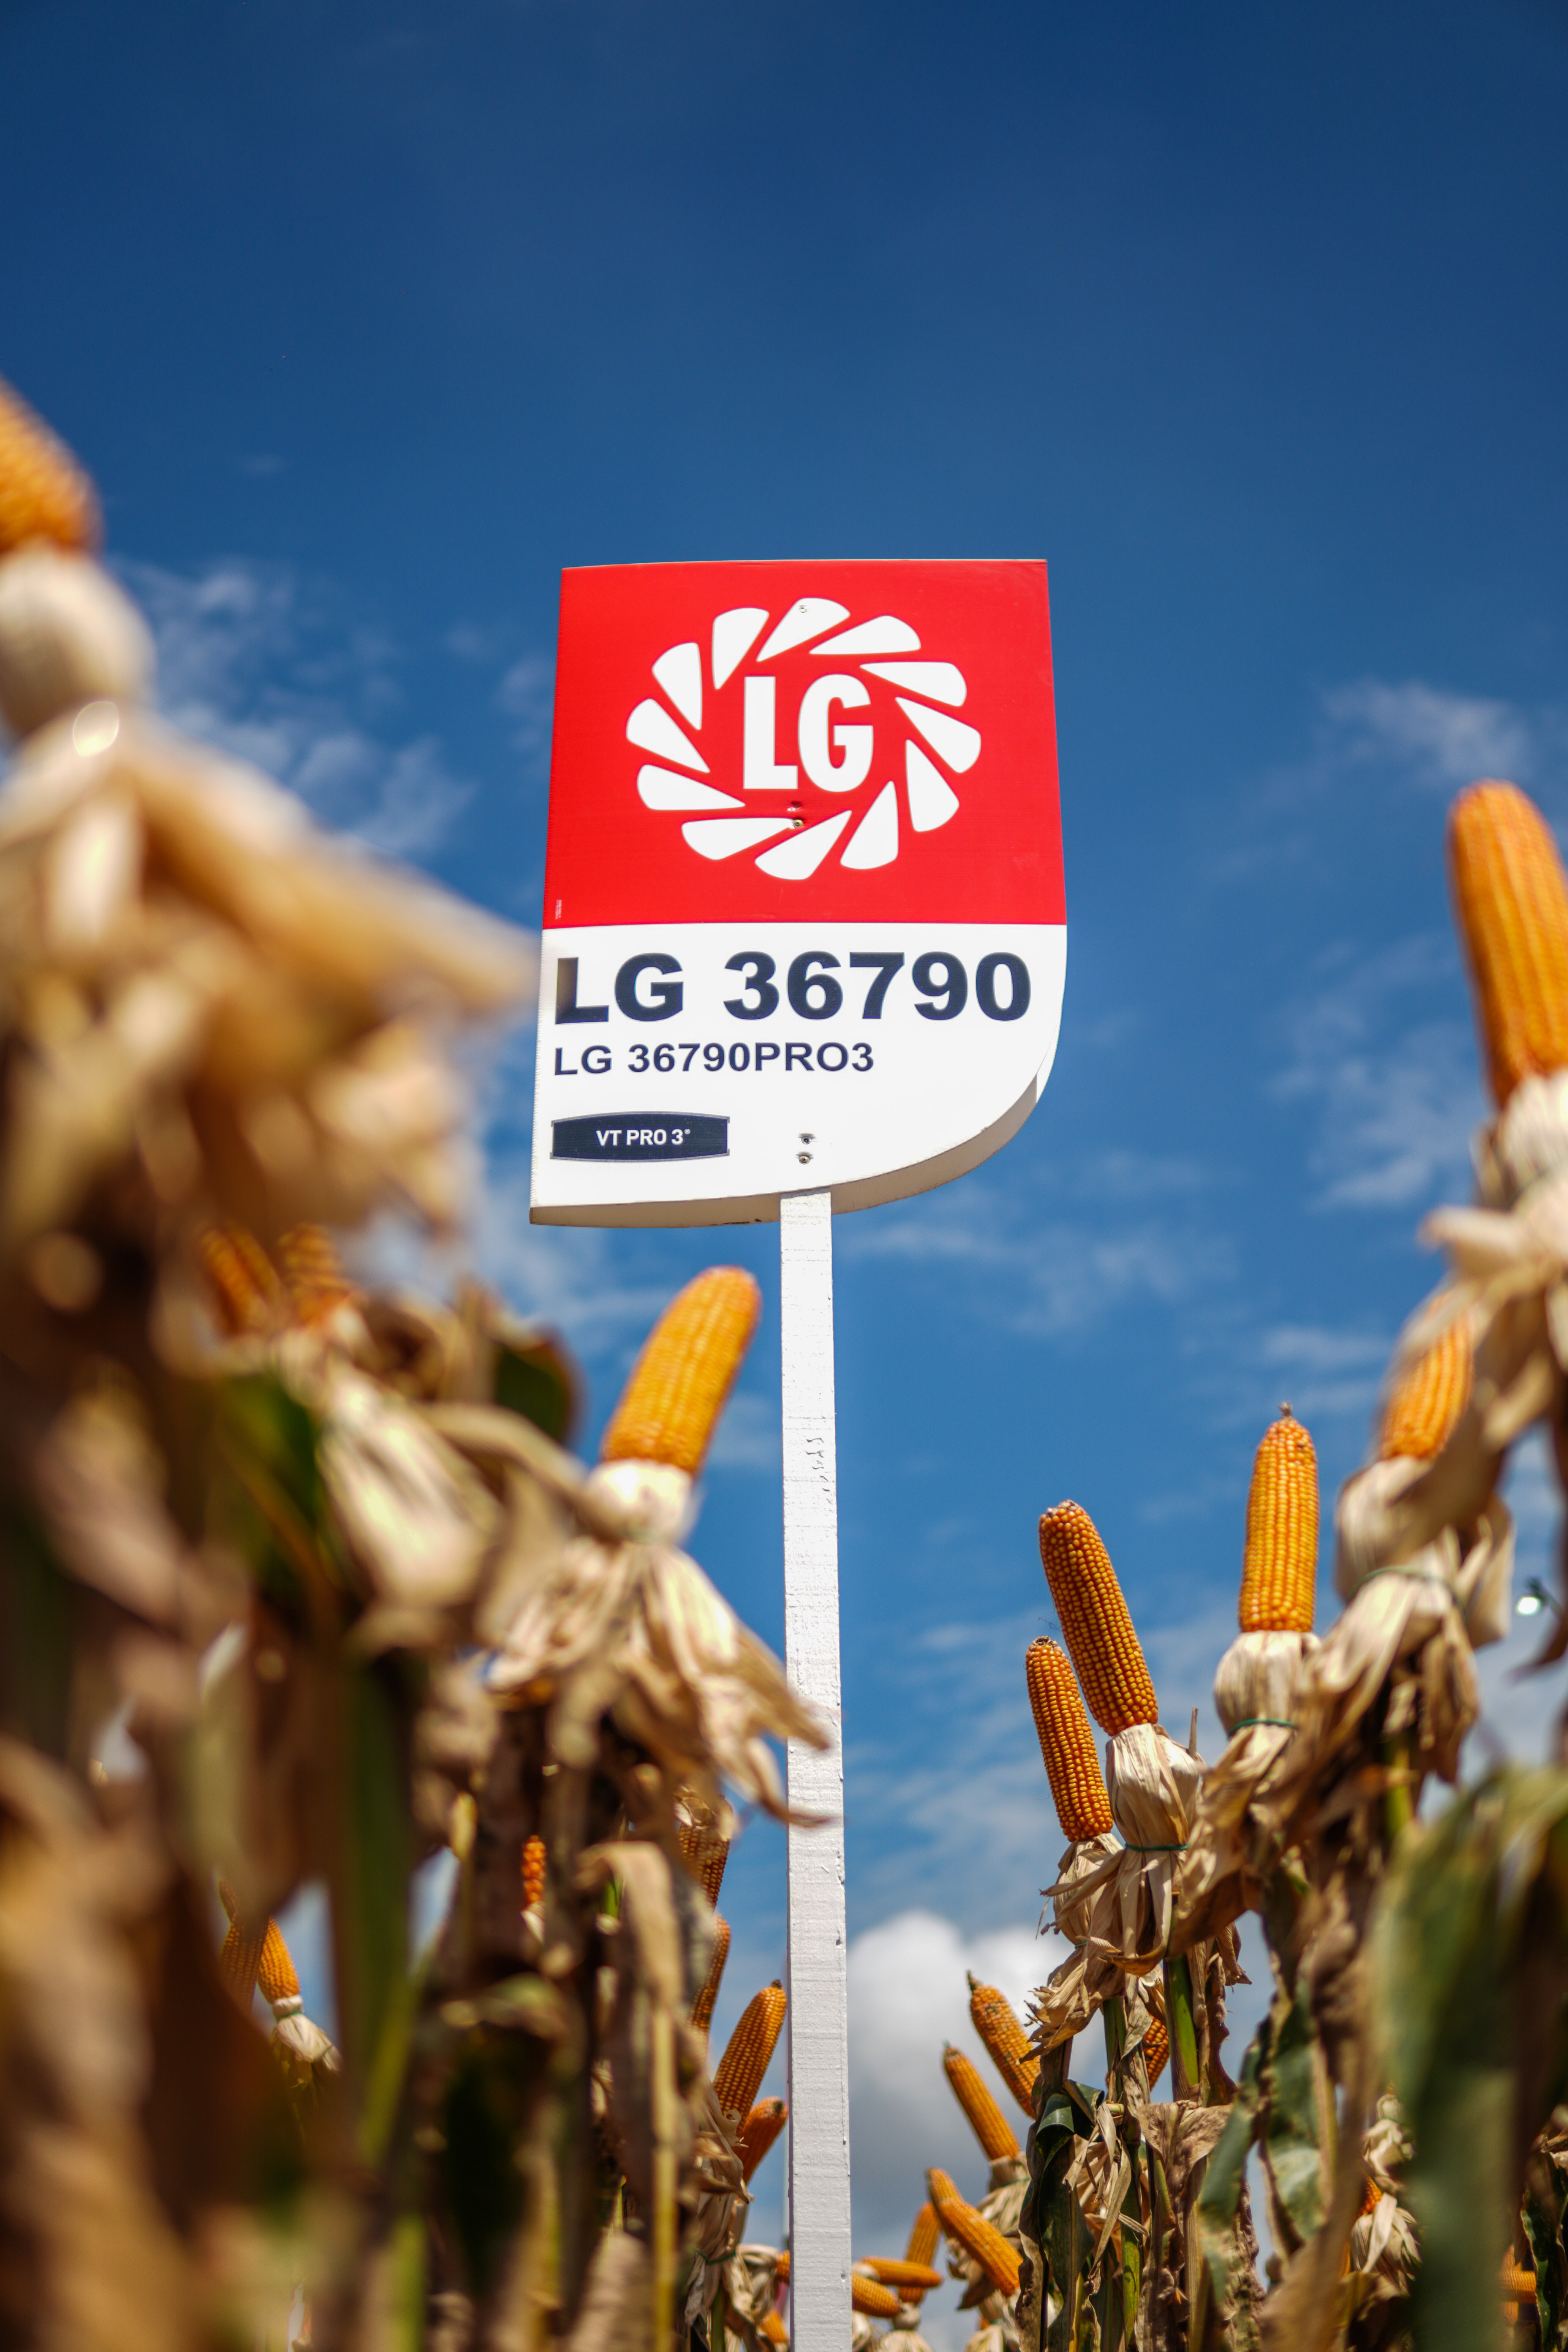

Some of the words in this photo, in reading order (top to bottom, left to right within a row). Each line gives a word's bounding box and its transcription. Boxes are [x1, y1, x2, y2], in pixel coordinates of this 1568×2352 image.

[743, 674, 874, 792] LG
[555, 953, 683, 1024] LG
[723, 951, 1031, 1021] 36790
[555, 1045, 612, 1075] LG
[628, 1042, 874, 1073] 36790PRO3
[596, 1130, 622, 1146] VT
[626, 1129, 667, 1145] PRO
